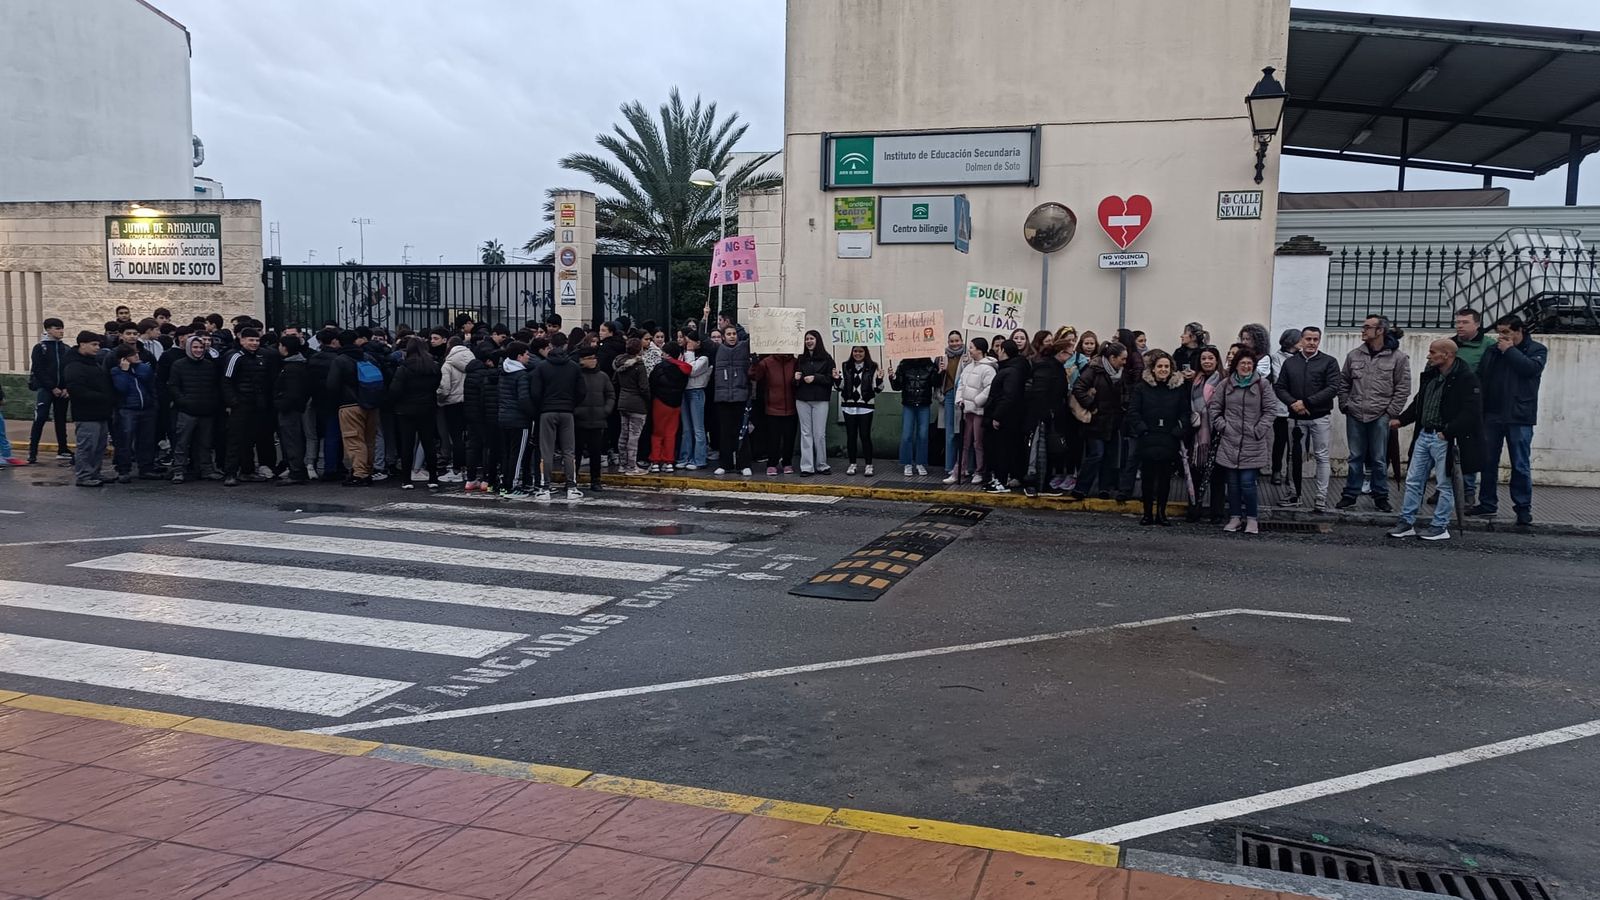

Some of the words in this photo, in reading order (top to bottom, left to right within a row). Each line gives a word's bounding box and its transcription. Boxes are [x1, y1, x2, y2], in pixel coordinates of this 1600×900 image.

[884, 151, 916, 160] Instituto
[918, 151, 928, 159] de
[930, 149, 972, 159] Educación
[974, 147, 1021, 158] Secundaria
[965, 163, 992, 172] Dolmen
[994, 162, 1003, 171] de
[1005, 162, 1021, 171] Soto
[1233, 194, 1260, 204] CALLE
[1220, 205, 1258, 217] SEVILLA
[153, 223, 164, 233] DE
[892, 223, 918, 233] Centro
[919, 223, 948, 235] bilingüe
[112, 242, 137, 256] Instituto
[138, 243, 146, 256] de
[180, 242, 215, 257] Secundaria
[128, 262, 169, 275] DOLMEN
[173, 262, 186, 275] DE
[188, 262, 216, 276] SOTO
[832, 302, 880, 314] SOLUCIÓN
[984, 302, 1000, 315] DE
[967, 314, 1018, 331] CALIDAD
[372, 613, 630, 714] ZANCADAS
